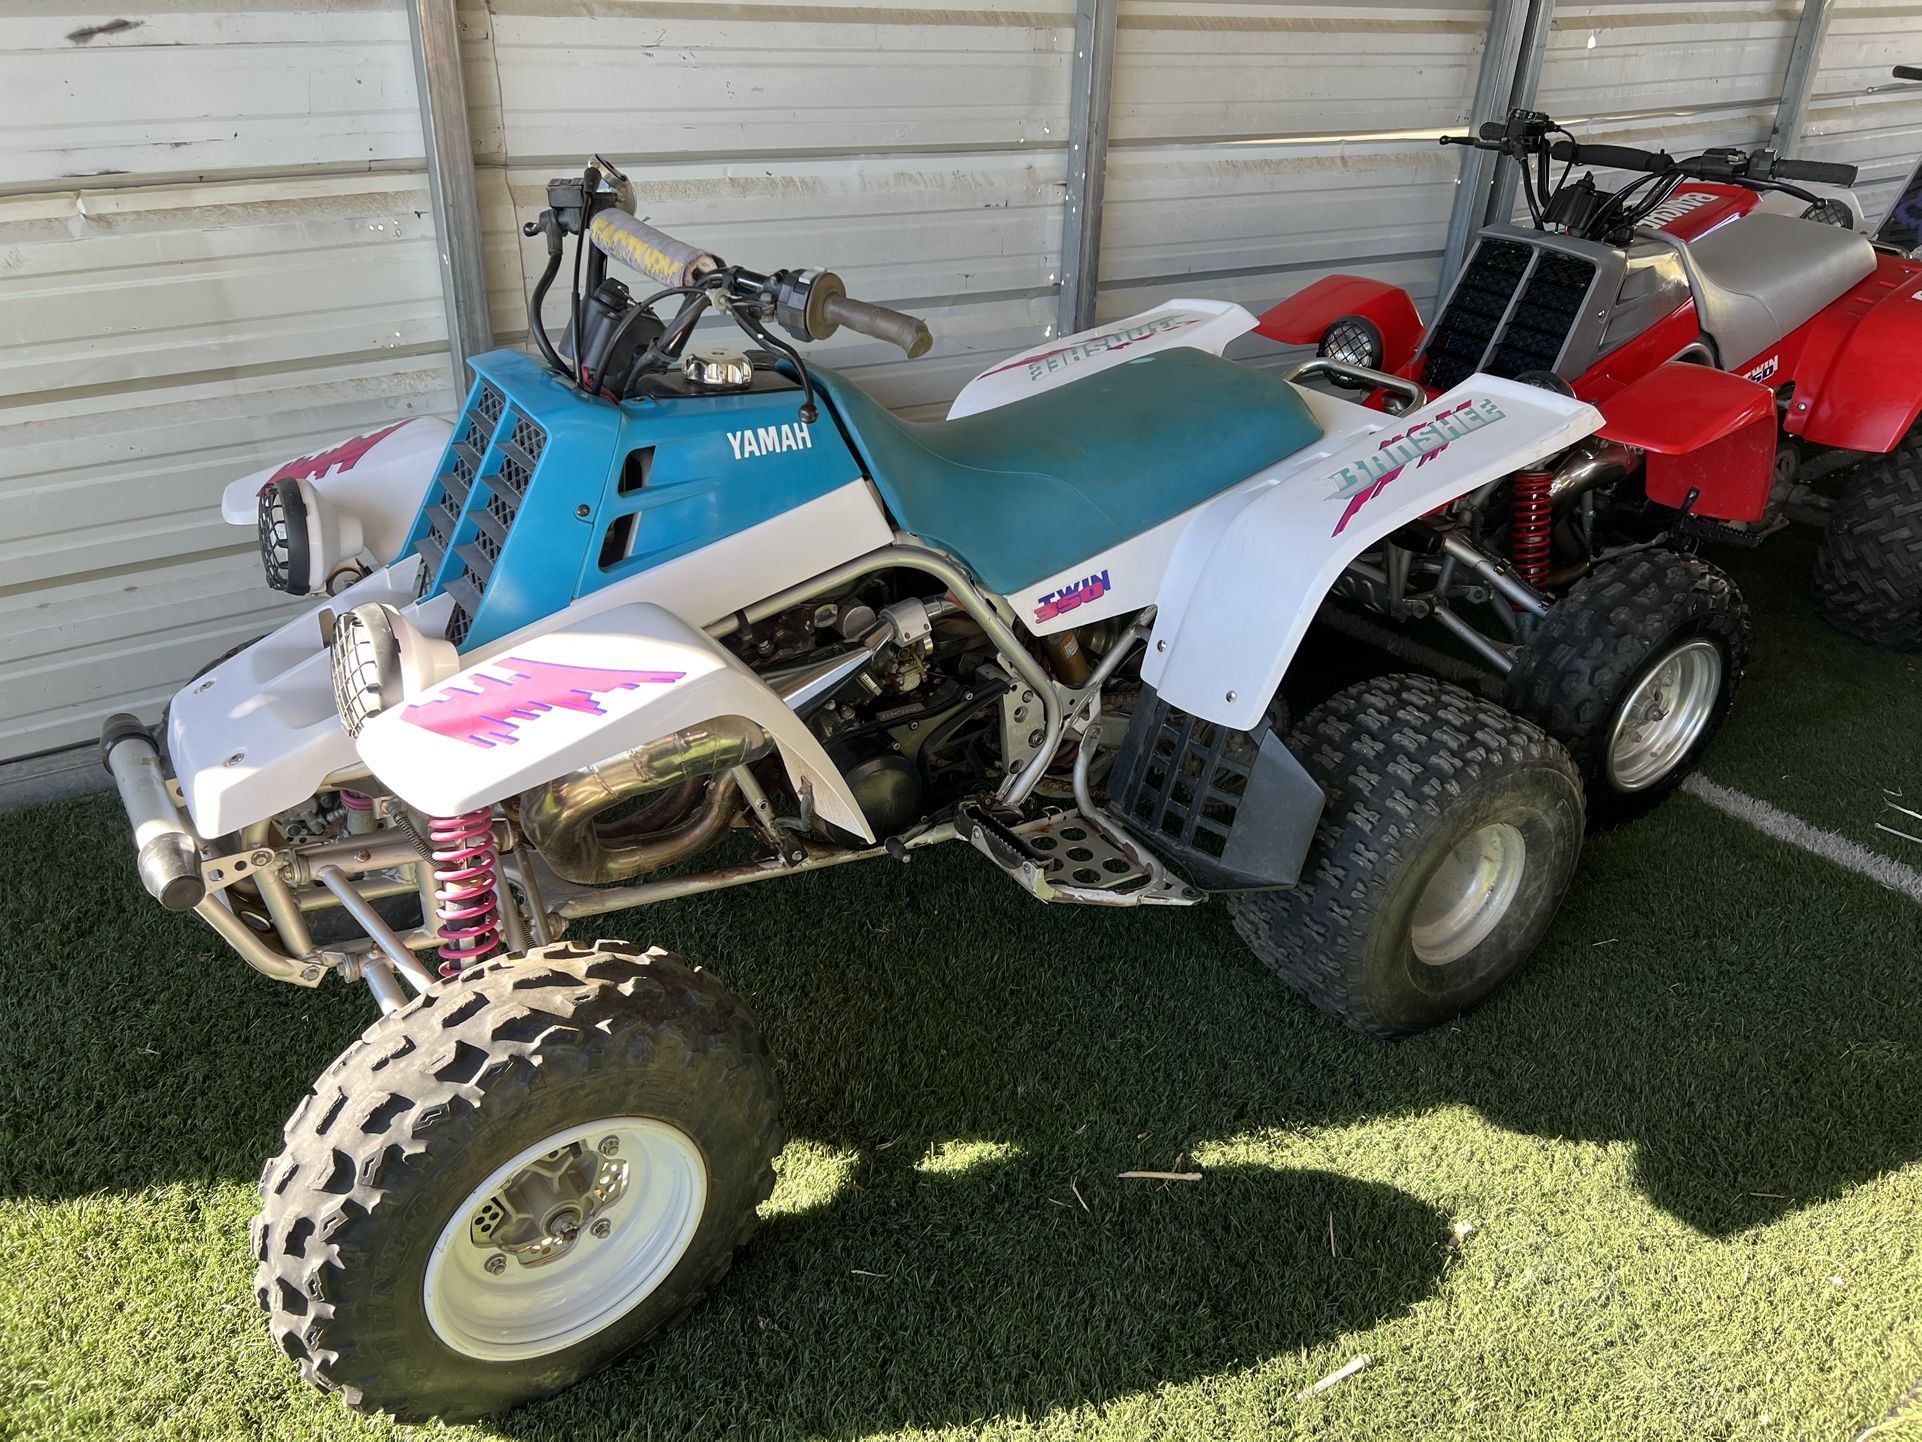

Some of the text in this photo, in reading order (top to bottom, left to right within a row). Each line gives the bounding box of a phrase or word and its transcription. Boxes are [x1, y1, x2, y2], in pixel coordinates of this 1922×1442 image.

[726, 422, 812, 460] YAMAH
[1325, 398, 1506, 499] BANSHEE
[1033, 581, 1105, 624] 350
[1038, 569, 1111, 607] TWIN
